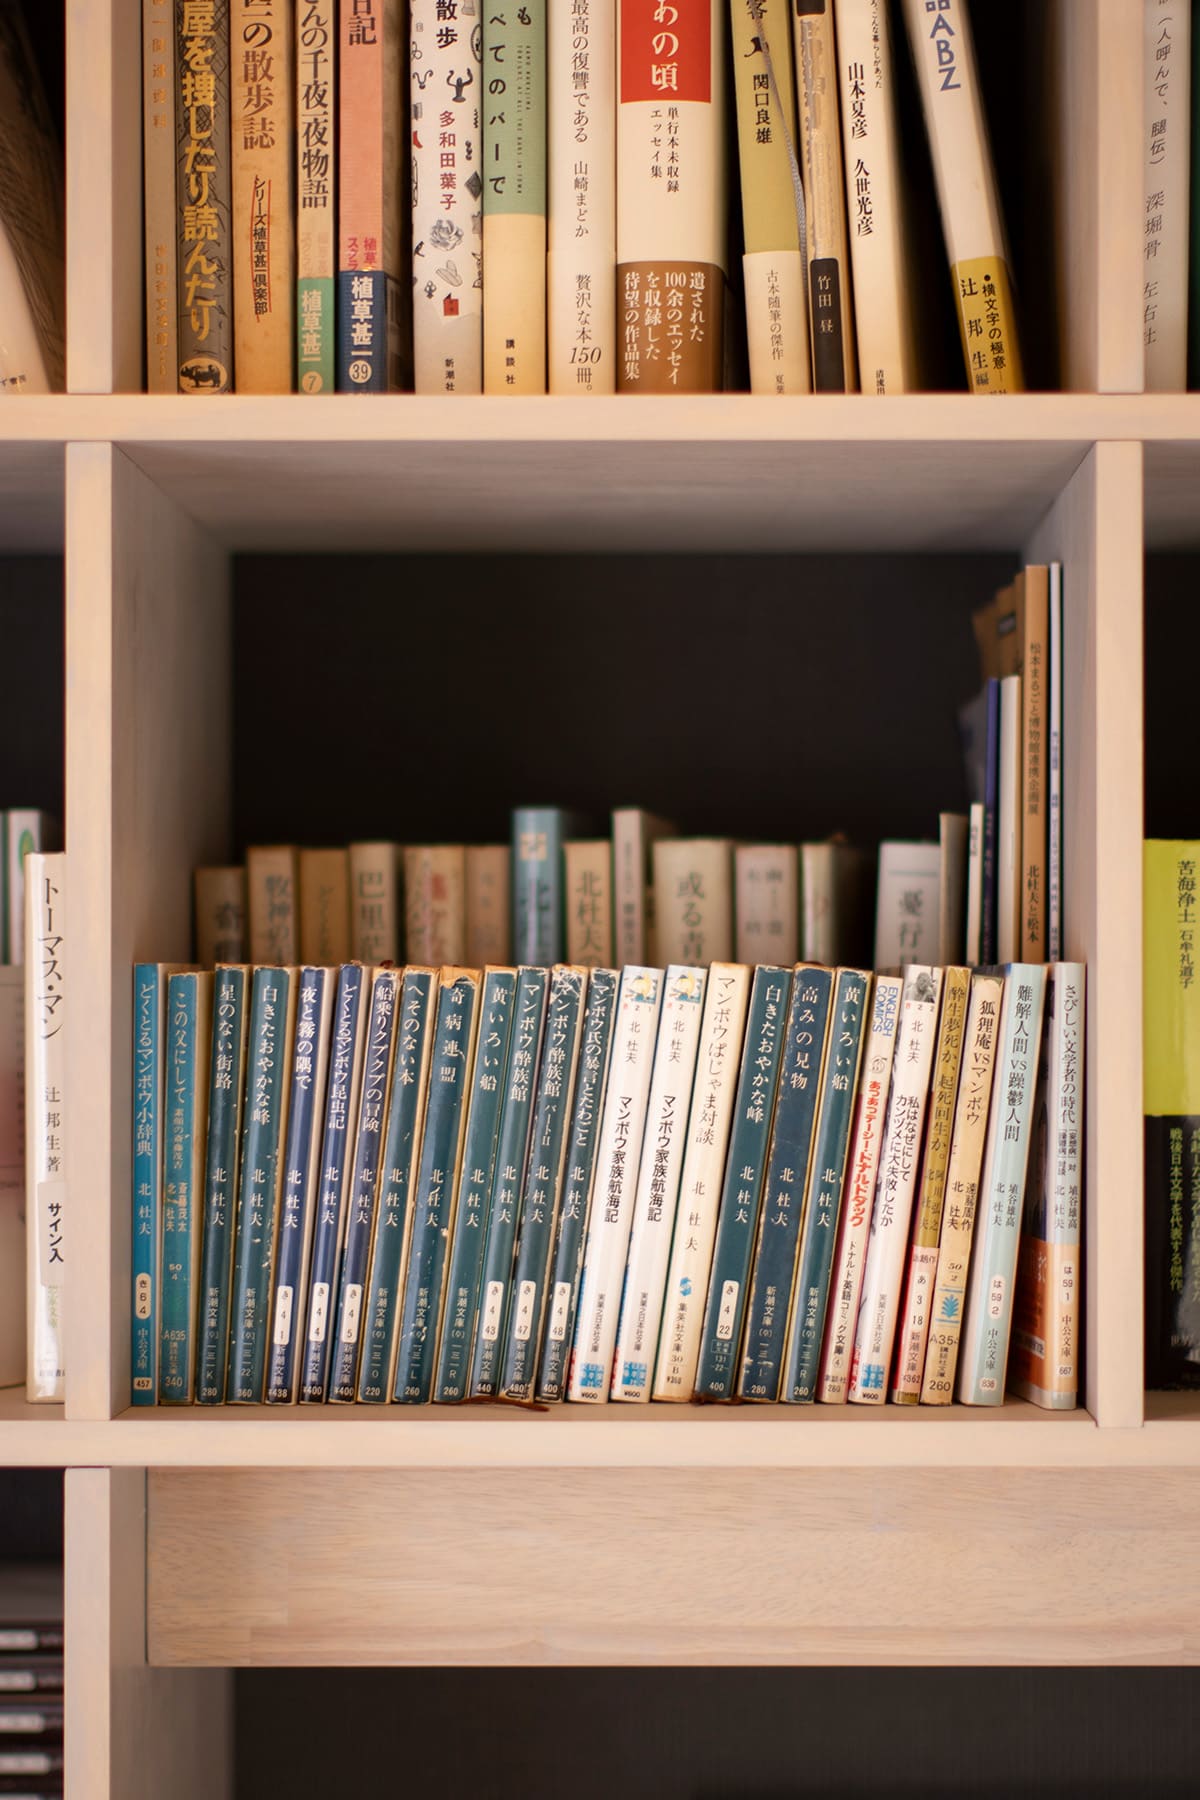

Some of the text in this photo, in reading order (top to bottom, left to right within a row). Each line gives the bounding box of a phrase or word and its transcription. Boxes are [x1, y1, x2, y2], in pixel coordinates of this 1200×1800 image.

[349, 0, 377, 46] 日記
[436, 0, 458, 48] 散歩
[517, 8, 531, 26] も
[651, 0, 679, 91] あの頃
[242, 0, 276, 150] 一の散歩誌
[571, 0, 589, 143] 最高の復讐である
[848, 62, 868, 139] 山本夏彦
[489, 12, 506, 194] べてのバーで
[752, 74, 772, 144] 関口良雄
[439, 111, 456, 210] 多和田葉子
[650, 108, 662, 178] エッセイ集
[668, 108, 679, 192] 単行本未収録
[574, 161, 589, 238] 山崎まどか
[854, 158, 873, 237] 久世光彦
[1144, 191, 1164, 260] 深堀骨
[301, 290, 322, 362] 植草甚一
[351, 276, 372, 356] 植草甚一
[624, 271, 640, 380] 待望の作品集
[644, 272, 661, 359] を収録した
[665, 272, 686, 384] 100余のエッセイ
[689, 272, 705, 341] 遺された
[766, 269, 784, 361] 古本随筆の傑作
[1143, 281, 1158, 346] 左右社
[352, 364, 369, 379] 39
[445, 359, 455, 391] 新潮社
[506, 339, 515, 384] 講談社
[1177, 861, 1196, 924] 苦海浄土
[38, 878, 64, 1040] トーマス・マン
[1179, 929, 1194, 989] 石牟礼道子
[216, 984, 235, 1090] 星のない街路
[295, 986, 317, 1090] 夜と霧の隅で
[400, 985, 424, 1085] へそのない本
[440, 988, 465, 1083] 奇病連盟
[872, 985, 888, 1032] COMICS
[883, 986, 898, 1037] ENGLISH
[174, 992, 188, 1104] この父にして
[251, 985, 277, 1125] 白きたおやかな峰
[329, 984, 357, 1130] どくとるマンボウ昆虫記
[362, 986, 393, 1133] 船乗りクプクプの冒険
[480, 988, 508, 1091] 黄いろい船
[510, 984, 540, 1102] マンボウ酔族館
[544, 985, 570, 1097] マンボウ酔族館
[575, 984, 609, 1147] マンボウ氏の暴言とたわごと
[625, 1021, 640, 1064] 北杜夫
[669, 1021, 685, 1063] 北杜夫
[746, 986, 781, 1123] 白きたおやかな峰
[791, 987, 819, 1090] 高みの見物
[832, 987, 860, 1091] 黄いろい船
[907, 1020, 923, 1064] 北杜夫
[966, 1001, 995, 1125] 狐狸庵VSマンボウ
[1004, 985, 1033, 1142] 難解人間VS躁鬱人間
[1060, 985, 1077, 1124] さびしい文学者の時代
[136, 984, 155, 1156] どくとるマンボウ小辞典
[931, 986, 964, 1160] 酔生夢死か、起死回生か。
[44, 1085, 61, 1173] 辻邦生著
[647, 1095, 676, 1222] マンボウ家族航海記
[899, 1096, 920, 1182] 私はなぜにして
[604, 1096, 632, 1223] マンボウ家族航海記
[880, 1095, 908, 1227] カンヅメに大失敗したか
[139, 1183, 151, 1235] 北杜夫
[212, 1168, 227, 1226] 北杜夫
[250, 1168, 265, 1226] 北杜夫
[284, 1169, 302, 1228] 北杜夫
[322, 1166, 338, 1225] 北杜夫
[356, 1169, 372, 1224] 北杜夫
[386, 1168, 403, 1227] 北杜夫
[426, 1169, 444, 1226] 北杜夫
[466, 1169, 485, 1227] 北杜夫
[498, 1167, 517, 1224] 北杜夫
[531, 1166, 549, 1222] 北杜夫
[567, 1166, 584, 1219] 北杜夫
[685, 1180, 705, 1251] 北杜夫
[735, 1166, 754, 1224] 北杜夫
[775, 1168, 794, 1226] 北杜夫
[817, 1168, 836, 1227] 北杜夫
[961, 1182, 976, 1231] 遠藤周作
[991, 1181, 1005, 1226] 北杜夫
[1005, 1184, 1018, 1227] 埴谷雄高
[1067, 1185, 1078, 1230] 埴谷雄高
[48, 1203, 64, 1264] サイン入
[139, 1280, 146, 1314] き 6 4
[172, 1273, 178, 1281] 4
[762, 1286, 777, 1327] 新潮文庫
[912, 1276, 926, 1325] あ 3 18
[994, 1280, 1001, 1288] は
[1062, 1279, 1073, 1288] 59
[1066, 1292, 1070, 1300] 1
[208, 1287, 220, 1328] 新潮文庫
[374, 1287, 389, 1328] 新潮文庫
[415, 1287, 429, 1328] 新潮文庫
[454, 1287, 469, 1327] 新潮文庫
[804, 1287, 819, 1327] 新潮文庫
[991, 1306, 999, 1315] 2
[1061, 1315, 1072, 1357] 中公文庫
[907, 1332, 920, 1371] 新潮文庫
[985, 1329, 999, 1370] 中公文庫
[136, 1380, 149, 1388] 457
[165, 1376, 183, 1386] 340
[365, 1386, 380, 1396] 220
[405, 1386, 420, 1396] 260
[443, 1386, 458, 1396] 260
[476, 1384, 491, 1392] 440
[543, 1384, 558, 1393] 400
[708, 1382, 724, 1391] 400
[751, 1385, 767, 1394] 280
[794, 1386, 809, 1396] 260
[929, 1381, 951, 1391] 260
